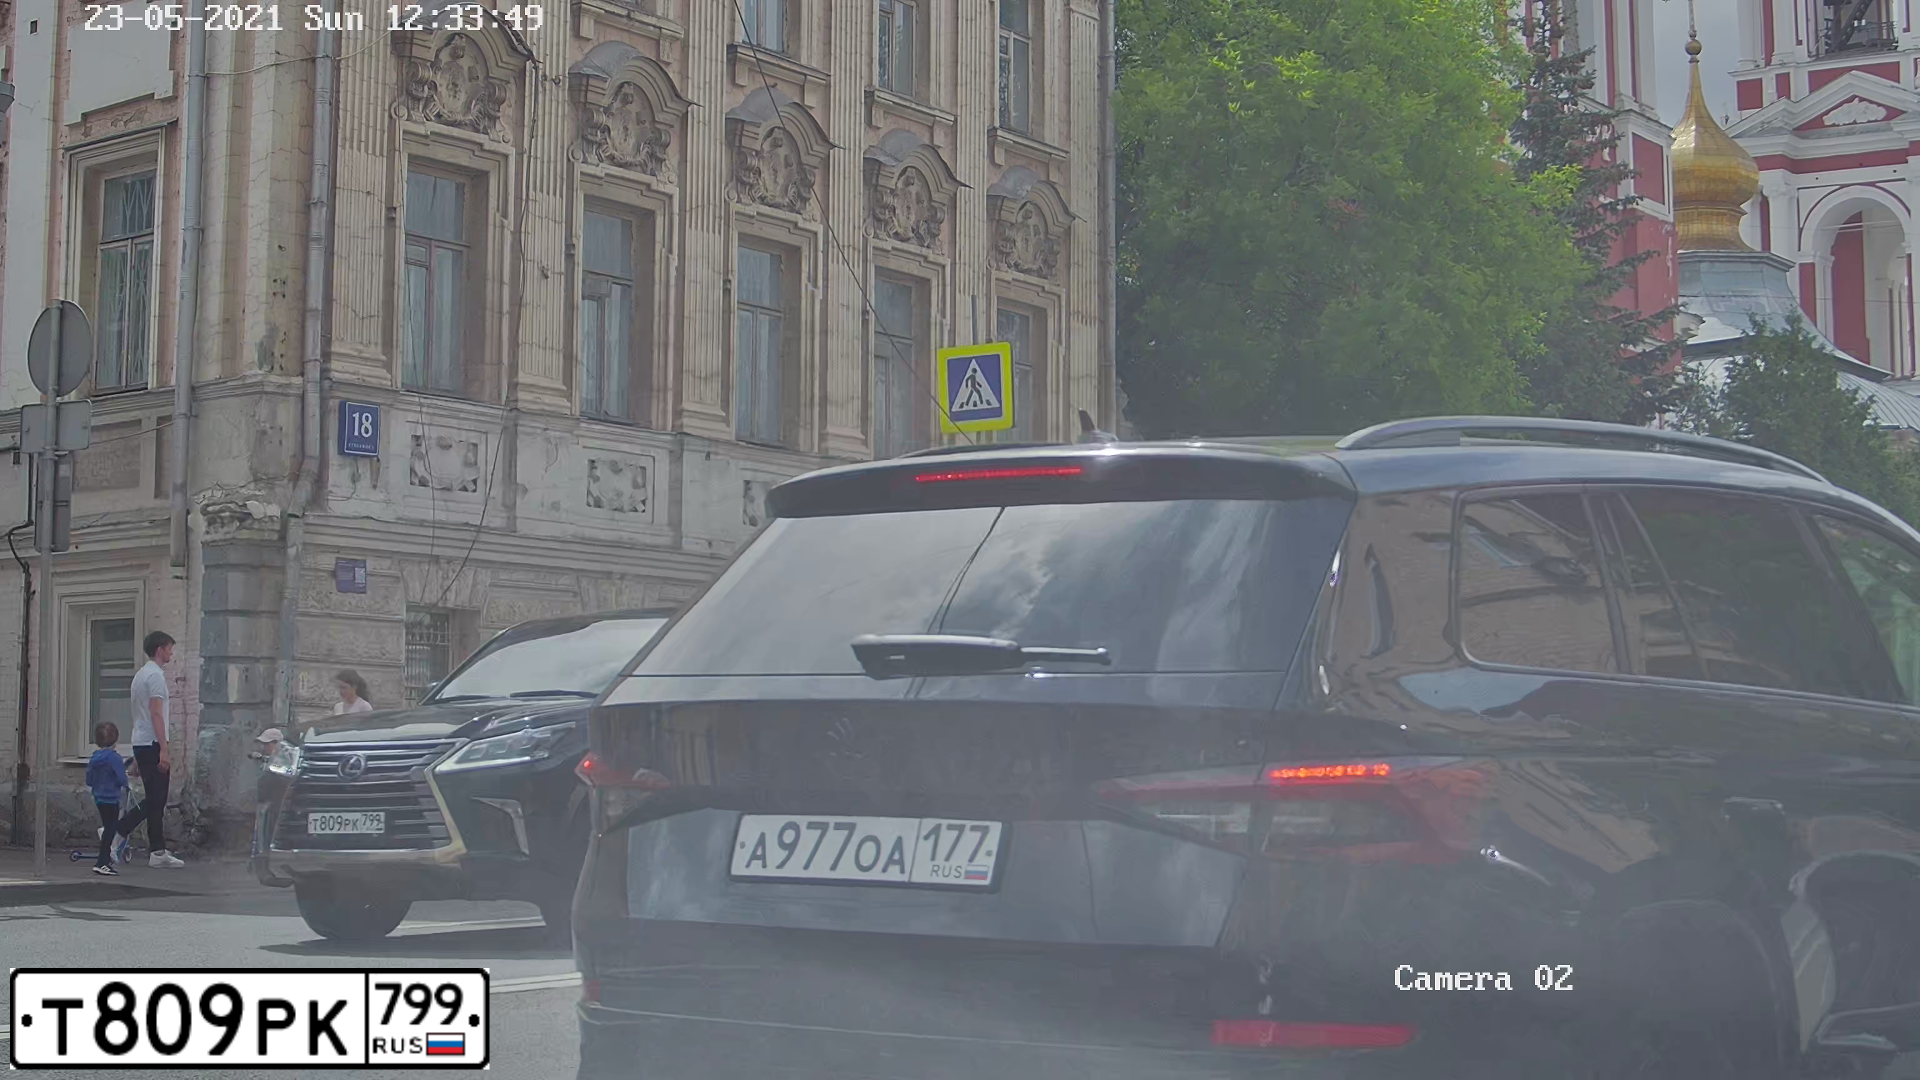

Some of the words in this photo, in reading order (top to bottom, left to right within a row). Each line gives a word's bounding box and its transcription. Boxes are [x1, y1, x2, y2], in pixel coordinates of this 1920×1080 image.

[352, 411, 373, 438] 18
[361, 813, 381, 827] 799
[923, 822, 991, 864] 177
[930, 864, 963, 879] RUS
